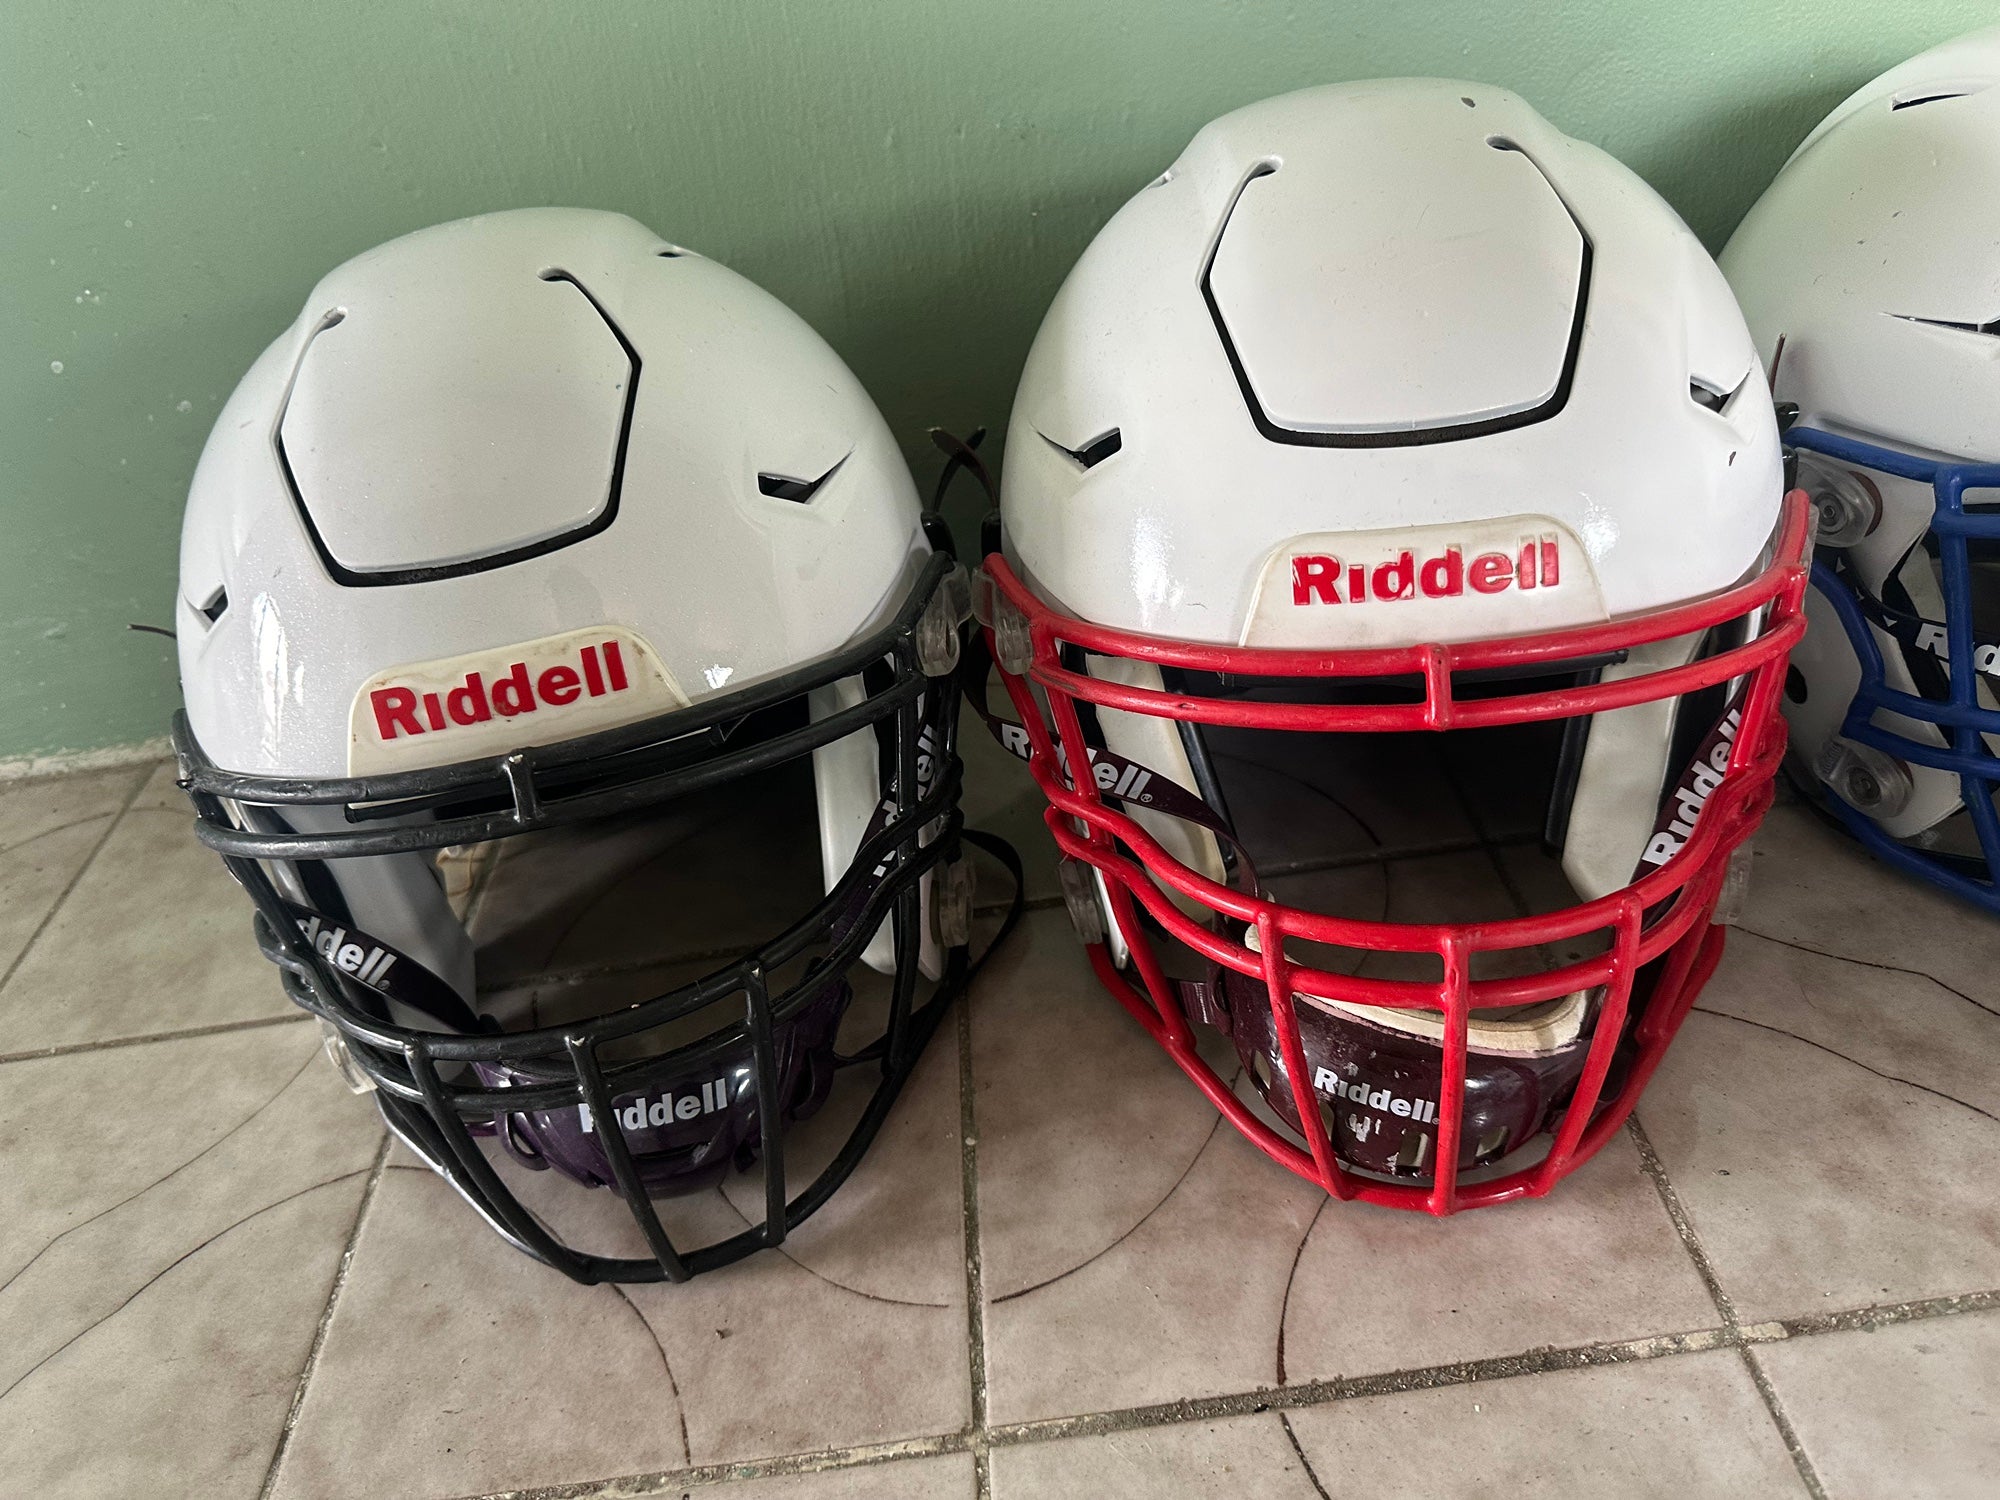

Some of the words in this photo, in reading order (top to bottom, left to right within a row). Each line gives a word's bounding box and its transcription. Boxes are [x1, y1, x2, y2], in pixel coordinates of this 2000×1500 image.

[1291, 532, 1559, 606] Riddell
[1915, 622, 2000, 676] Rd
[370, 640, 628, 740] Riddell
[297, 916, 398, 988] ddell
